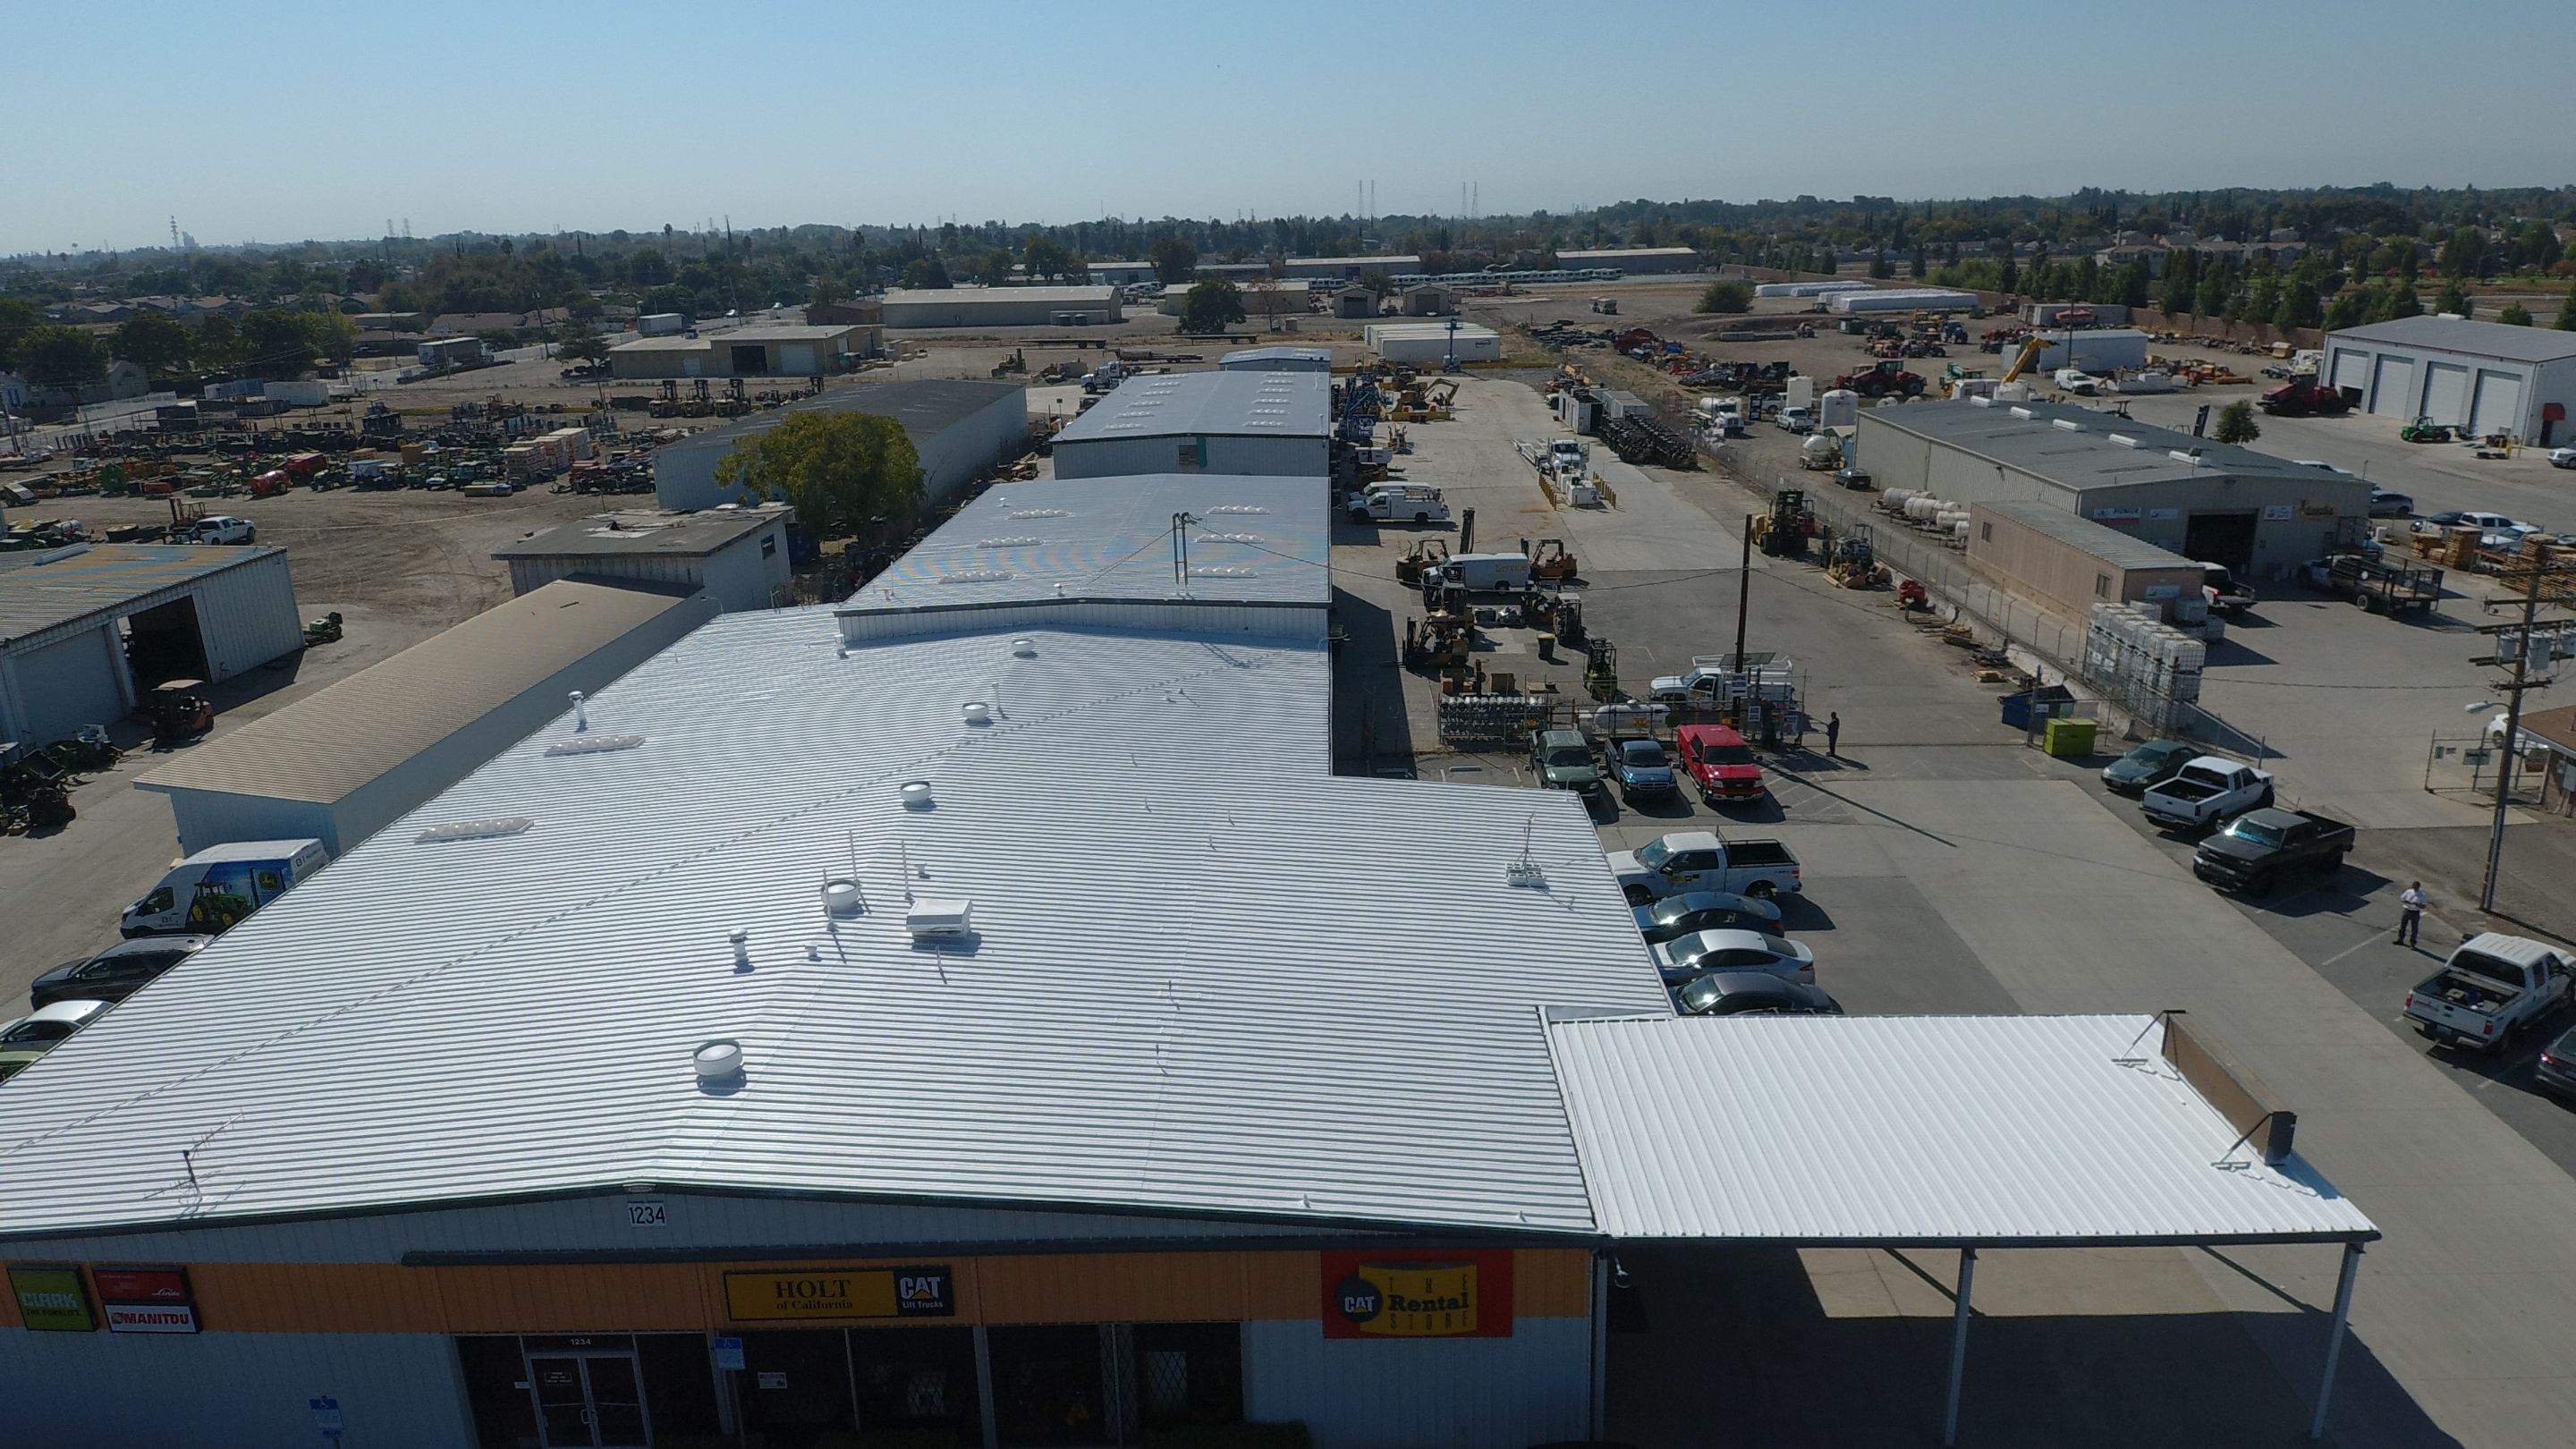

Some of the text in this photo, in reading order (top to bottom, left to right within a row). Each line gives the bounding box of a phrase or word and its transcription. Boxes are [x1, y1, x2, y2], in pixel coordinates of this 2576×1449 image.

[629, 1207, 665, 1224] 1234
[775, 1280, 851, 1298] HOLT
[900, 1277, 940, 1299] CAT
[776, 1300, 853, 1310] of California
[902, 1301, 943, 1309] Lift Trucks
[1344, 1295, 1375, 1313] CAT
[1388, 1292, 1469, 1311] Rental
[123, 1312, 189, 1324] MANITOU
